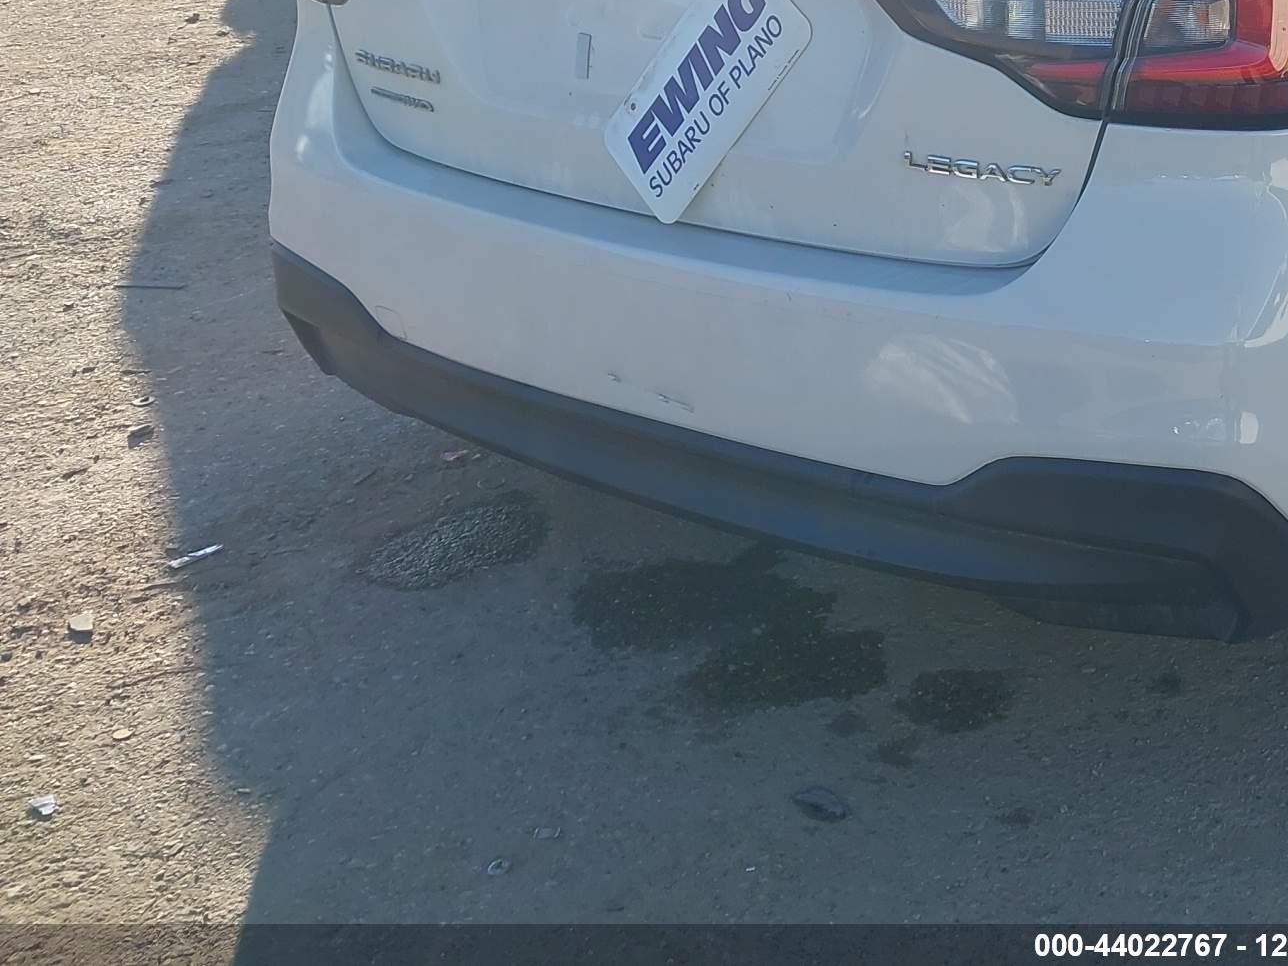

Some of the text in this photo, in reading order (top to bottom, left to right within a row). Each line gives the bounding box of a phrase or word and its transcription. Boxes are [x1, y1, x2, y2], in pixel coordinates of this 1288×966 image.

[649, 15, 783, 198] SUBARU OF PLANO
[904, 151, 1062, 186] LEGACY
